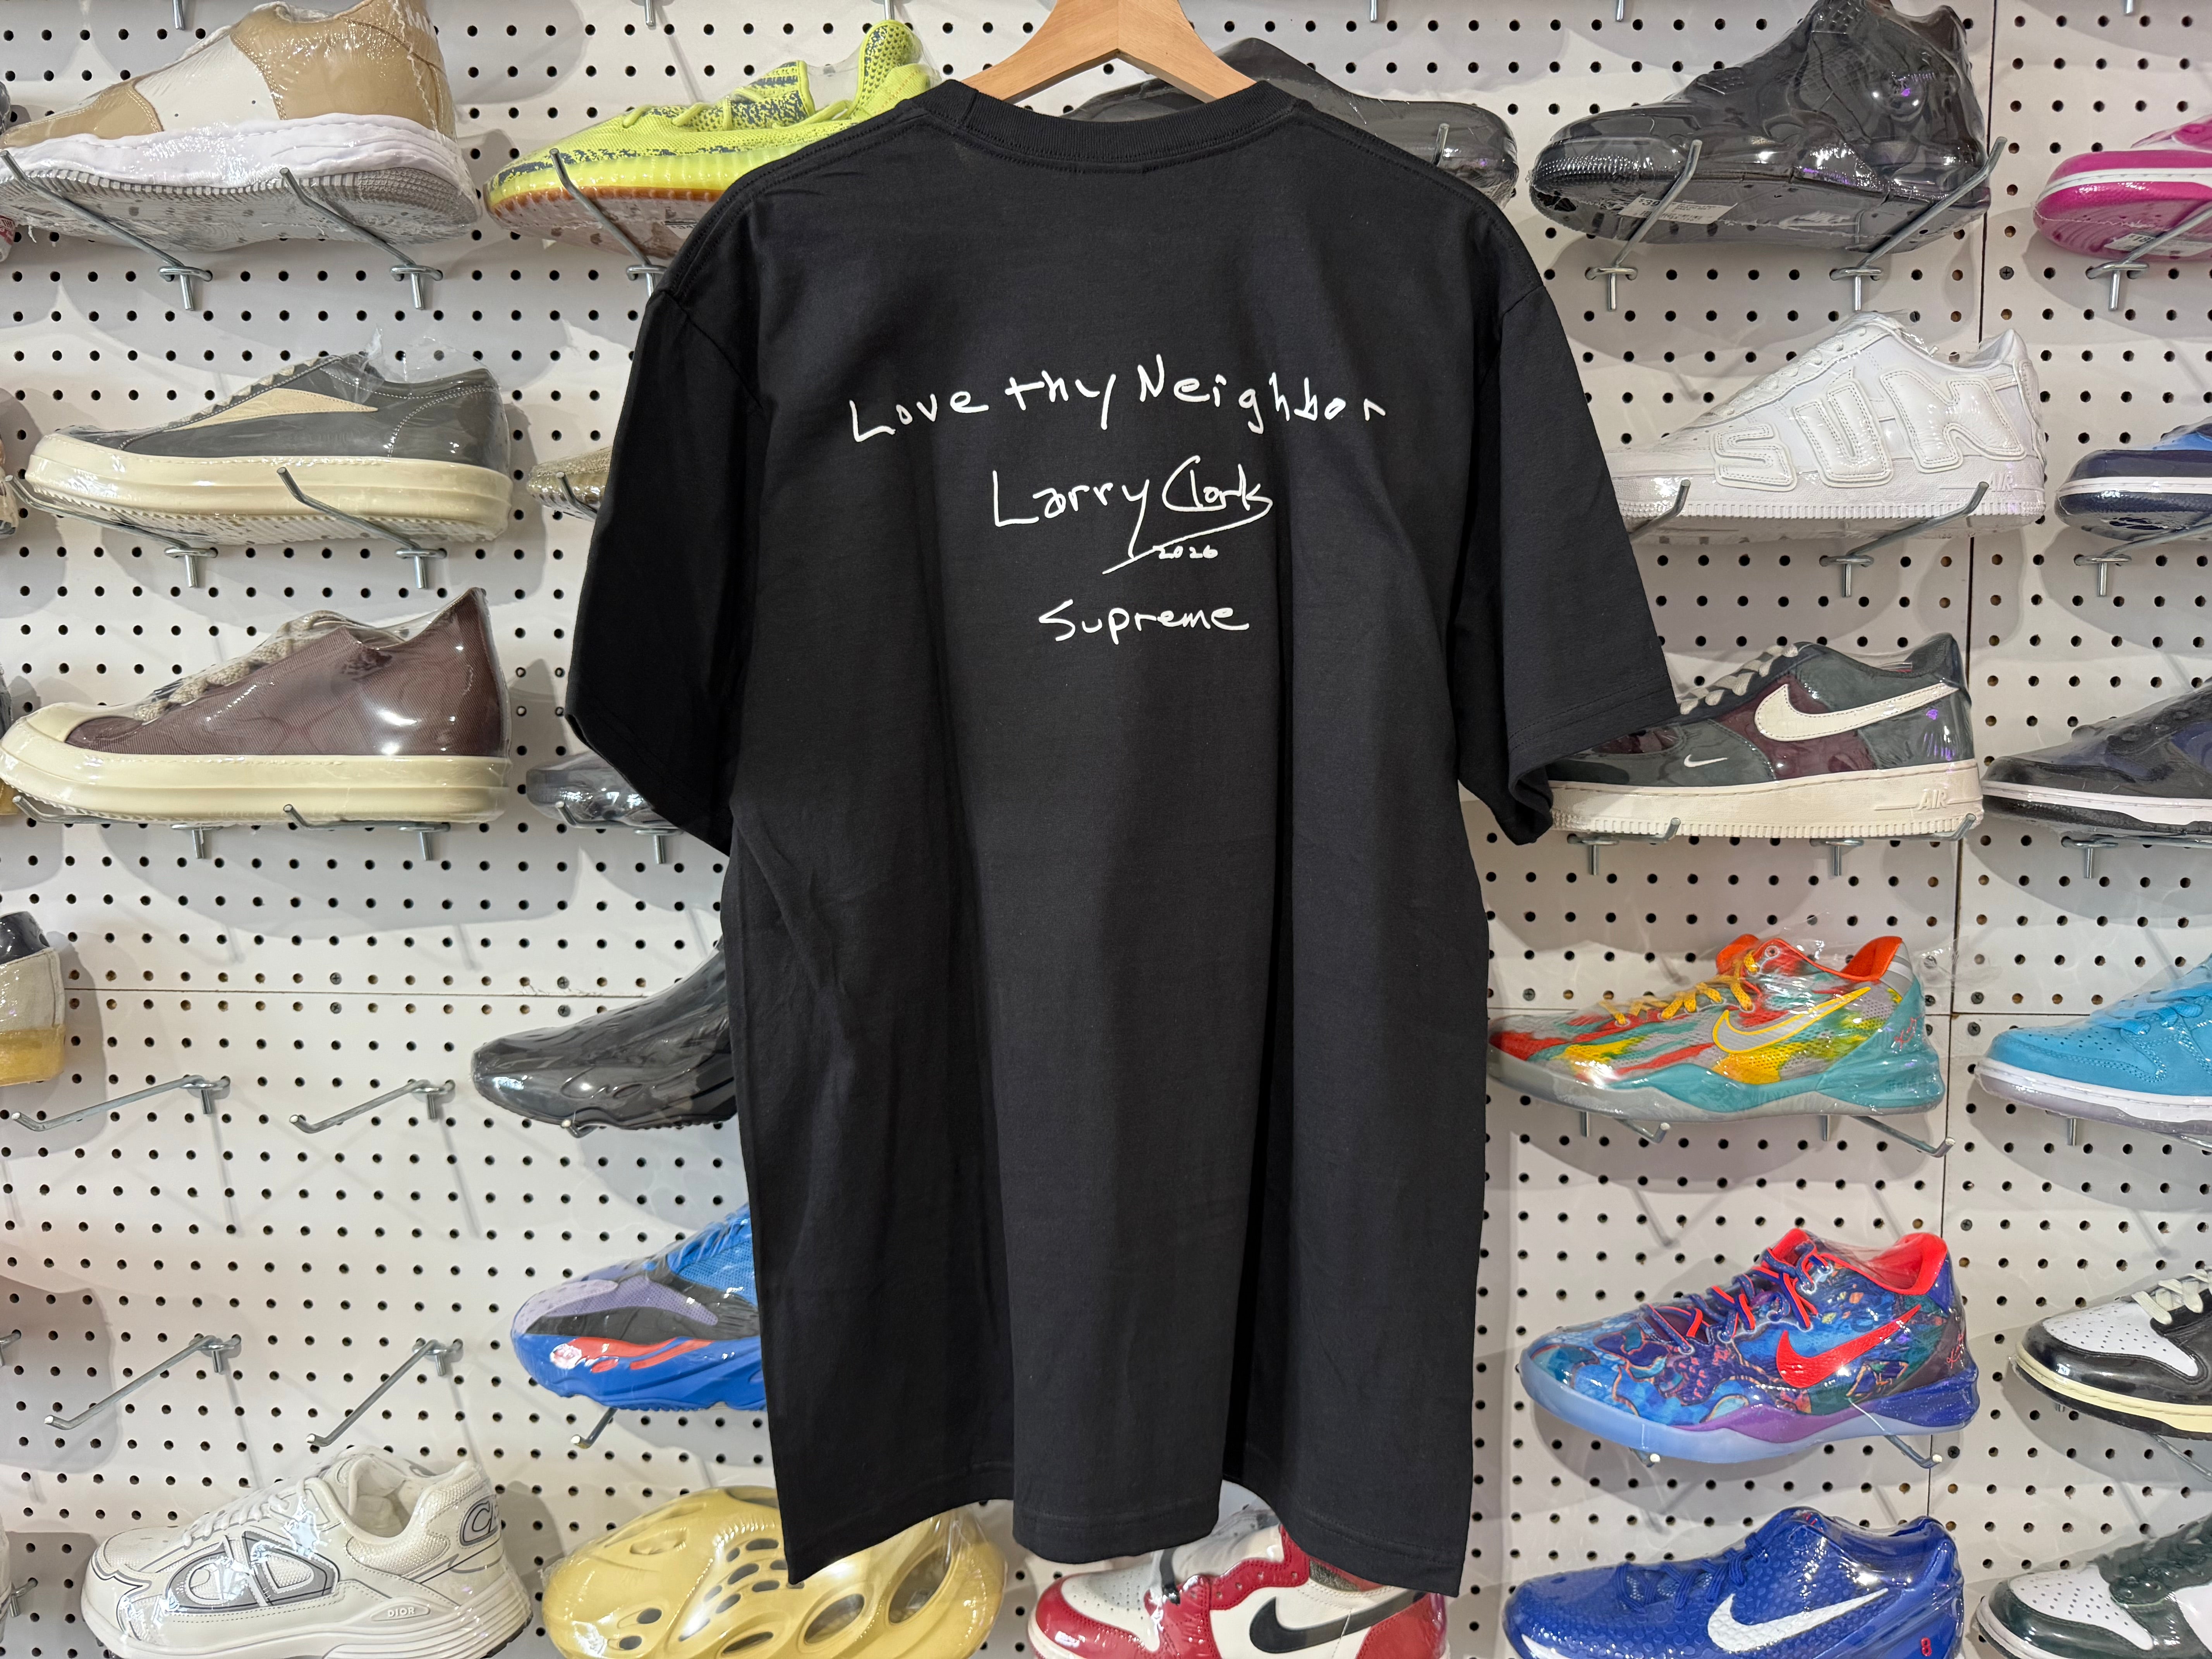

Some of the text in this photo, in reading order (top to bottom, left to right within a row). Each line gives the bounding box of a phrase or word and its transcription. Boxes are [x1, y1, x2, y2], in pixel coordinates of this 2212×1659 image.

[850, 354, 1385, 442] Love thy Neighbor
[993, 471, 1149, 558] Larry
[1154, 544, 1218, 560] 2026
[1039, 599, 1249, 644] Supreme
[1918, 788, 1947, 810] AIR
[388, 1606, 415, 1617] DIOR
[1921, 1637, 1932, 1657] 8
